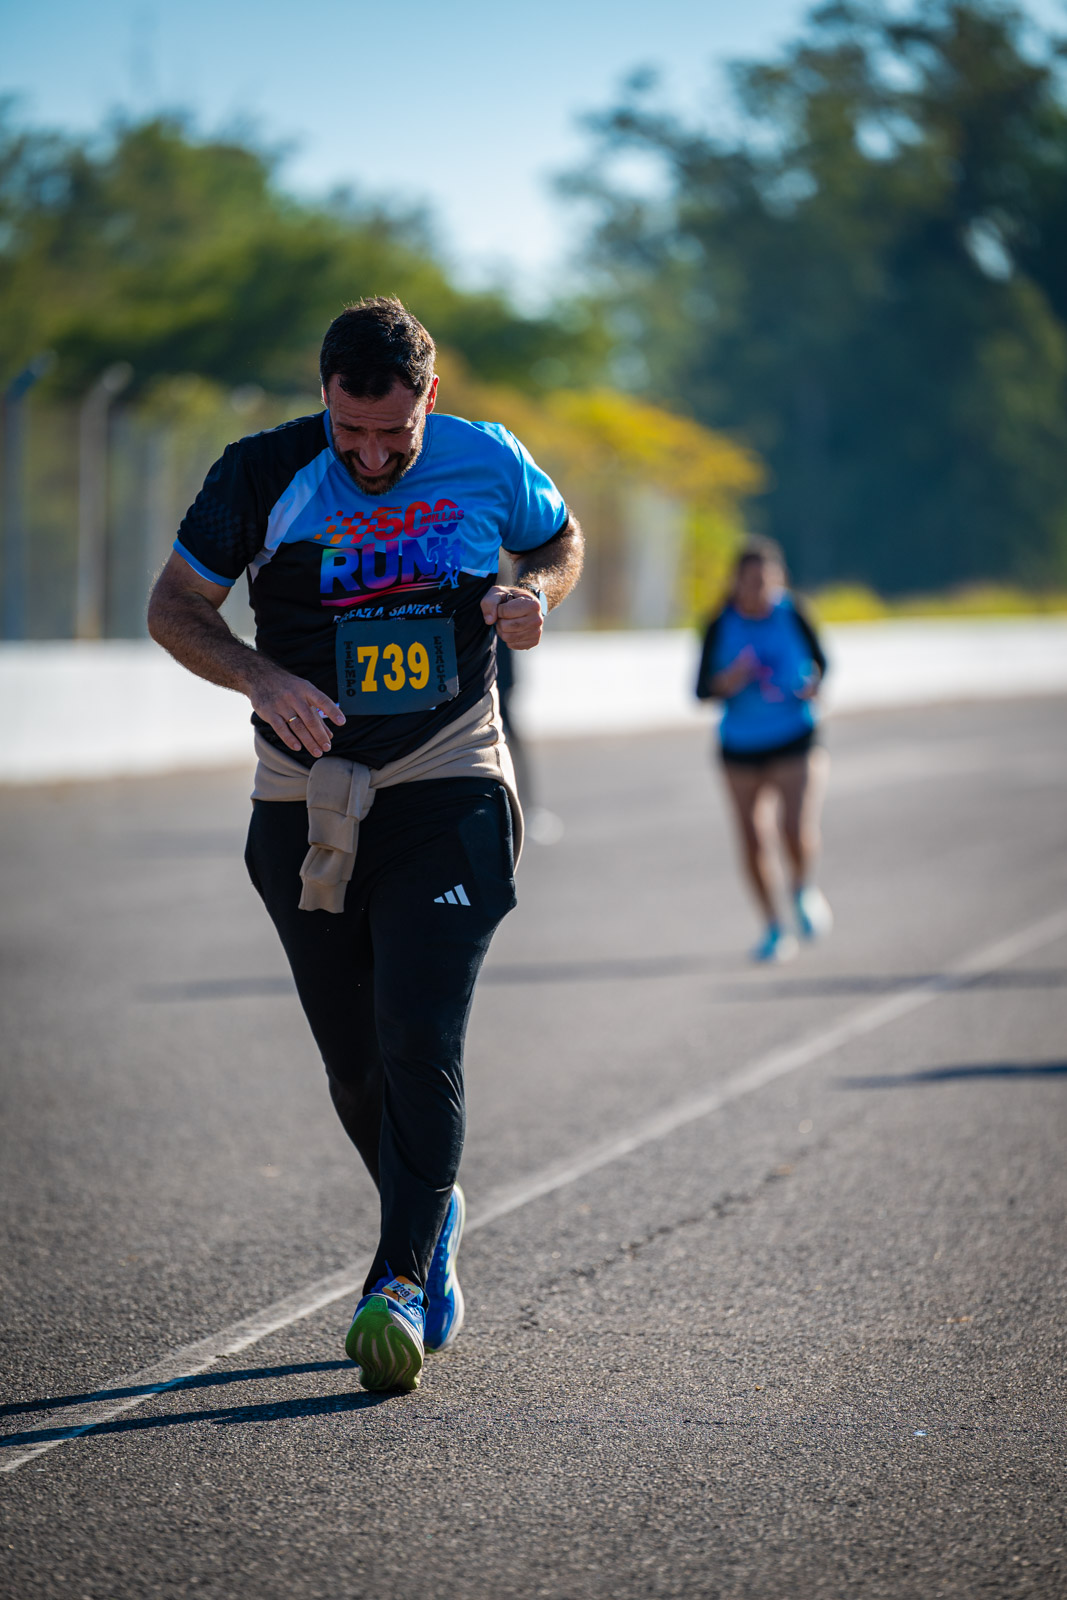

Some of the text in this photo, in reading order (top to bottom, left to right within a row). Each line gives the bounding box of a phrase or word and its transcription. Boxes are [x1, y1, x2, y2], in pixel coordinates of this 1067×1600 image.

[374, 499, 459, 541] 500
[420, 509, 465, 526] MILLAS
[320, 537, 449, 594] RUN
[344, 641, 356, 697] TIEMPO
[357, 641, 430, 692] 739
[433, 636, 447, 693] EXACTO
